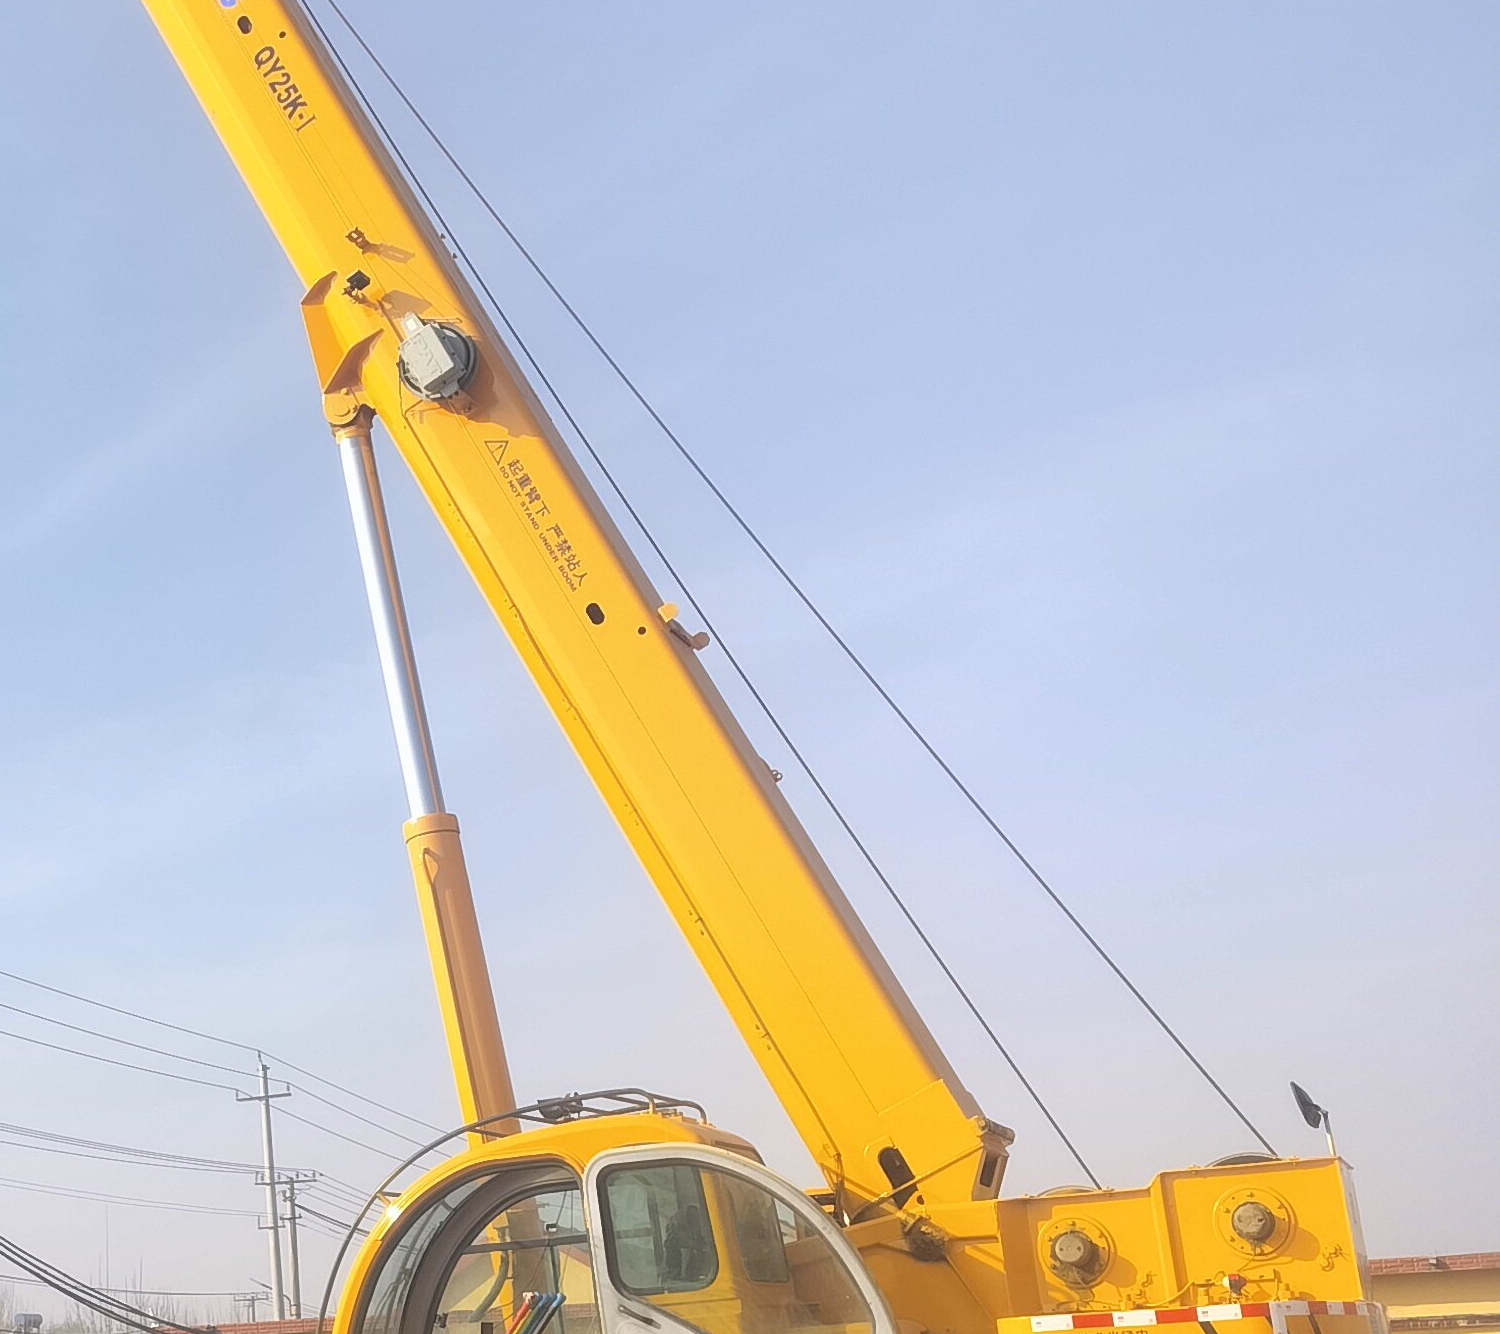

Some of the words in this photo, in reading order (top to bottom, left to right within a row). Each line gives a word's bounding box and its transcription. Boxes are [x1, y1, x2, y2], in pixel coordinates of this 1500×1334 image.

[499, 466, 510, 479] DO
[507, 479, 522, 498] NOT
[519, 500, 540, 530] STAND
[539, 533, 560, 563] UNDER
[558, 564, 577, 593] BOOM
[545, 523, 588, 587] 严禁站人
